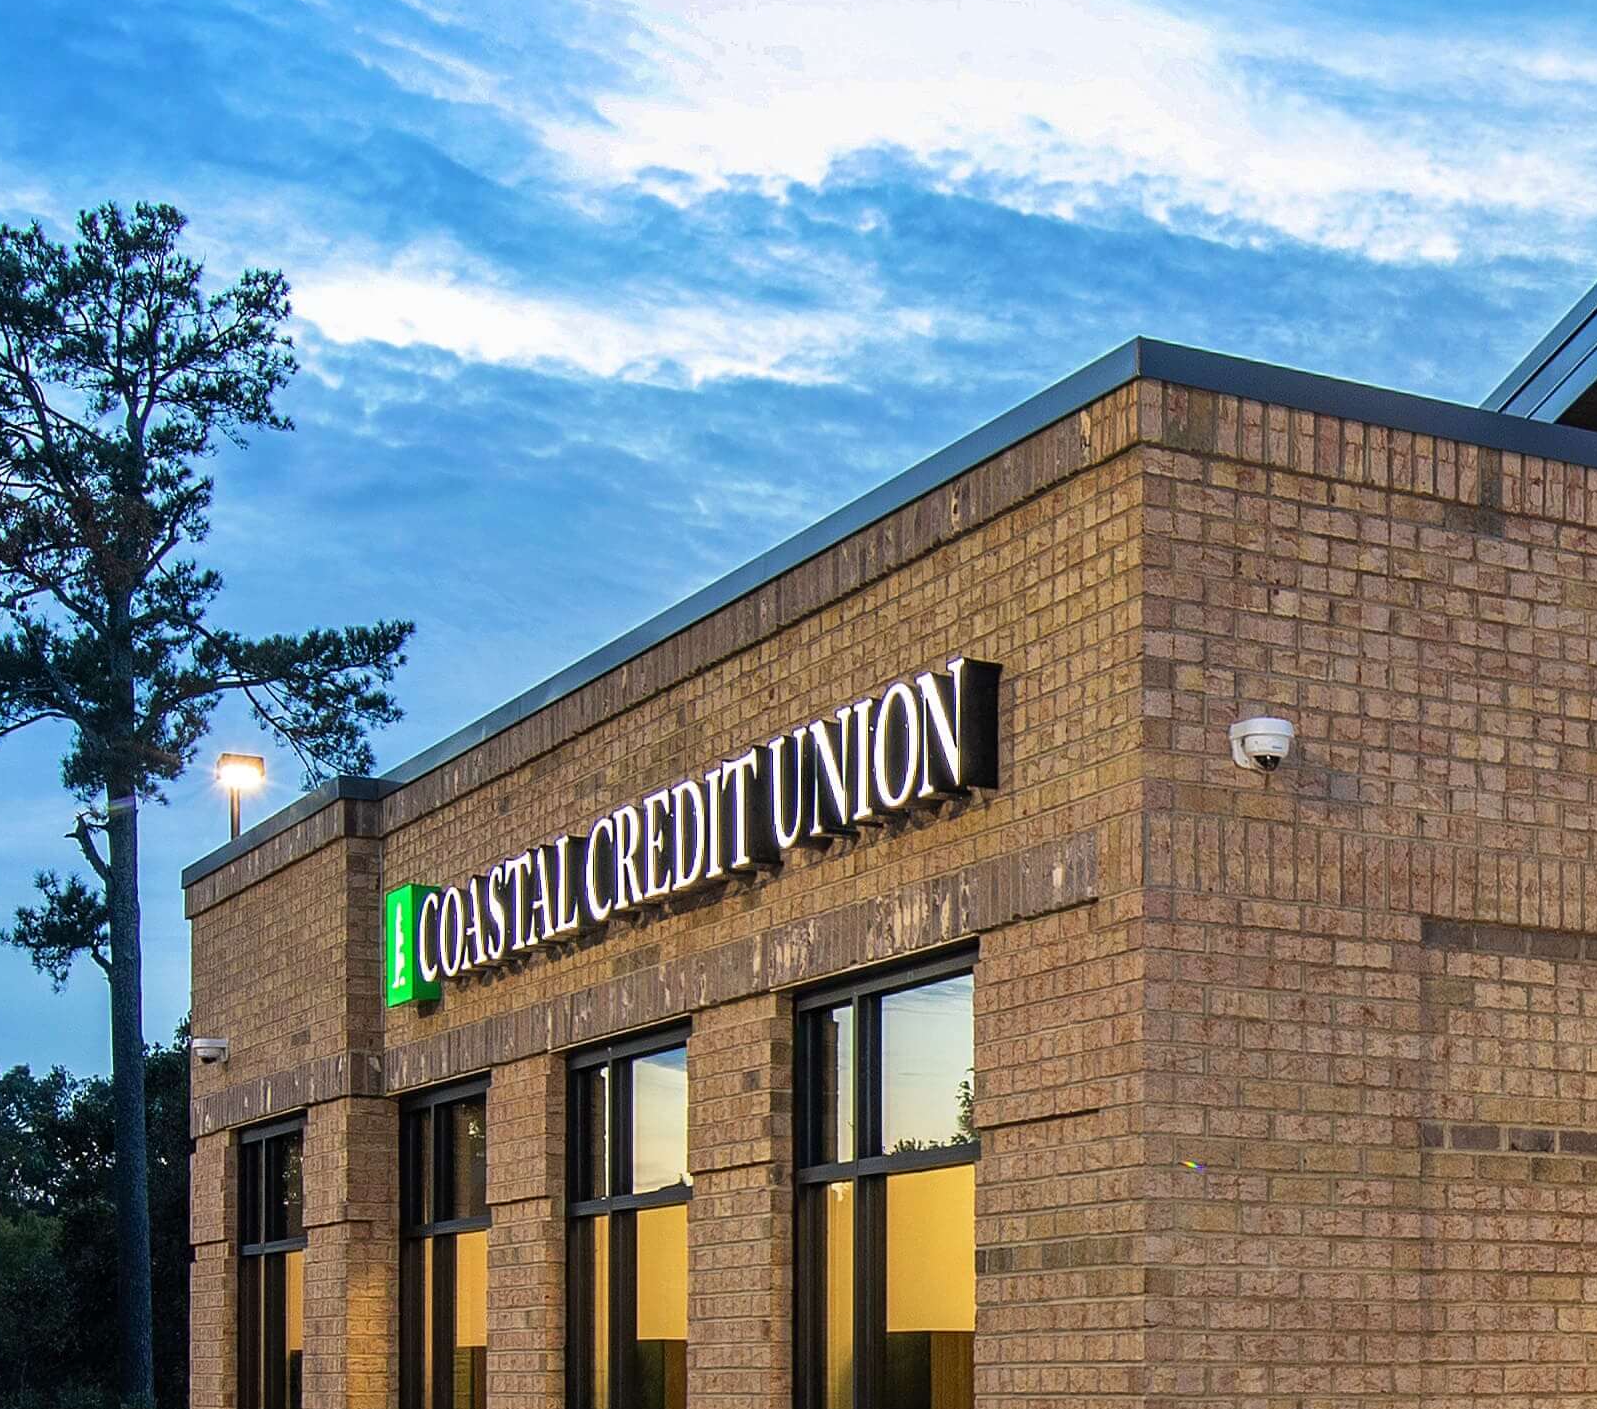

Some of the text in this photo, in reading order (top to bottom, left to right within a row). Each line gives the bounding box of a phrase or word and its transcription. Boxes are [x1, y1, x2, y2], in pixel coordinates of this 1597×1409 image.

[418, 657, 965, 983] COASTAL CREDIT UNION
